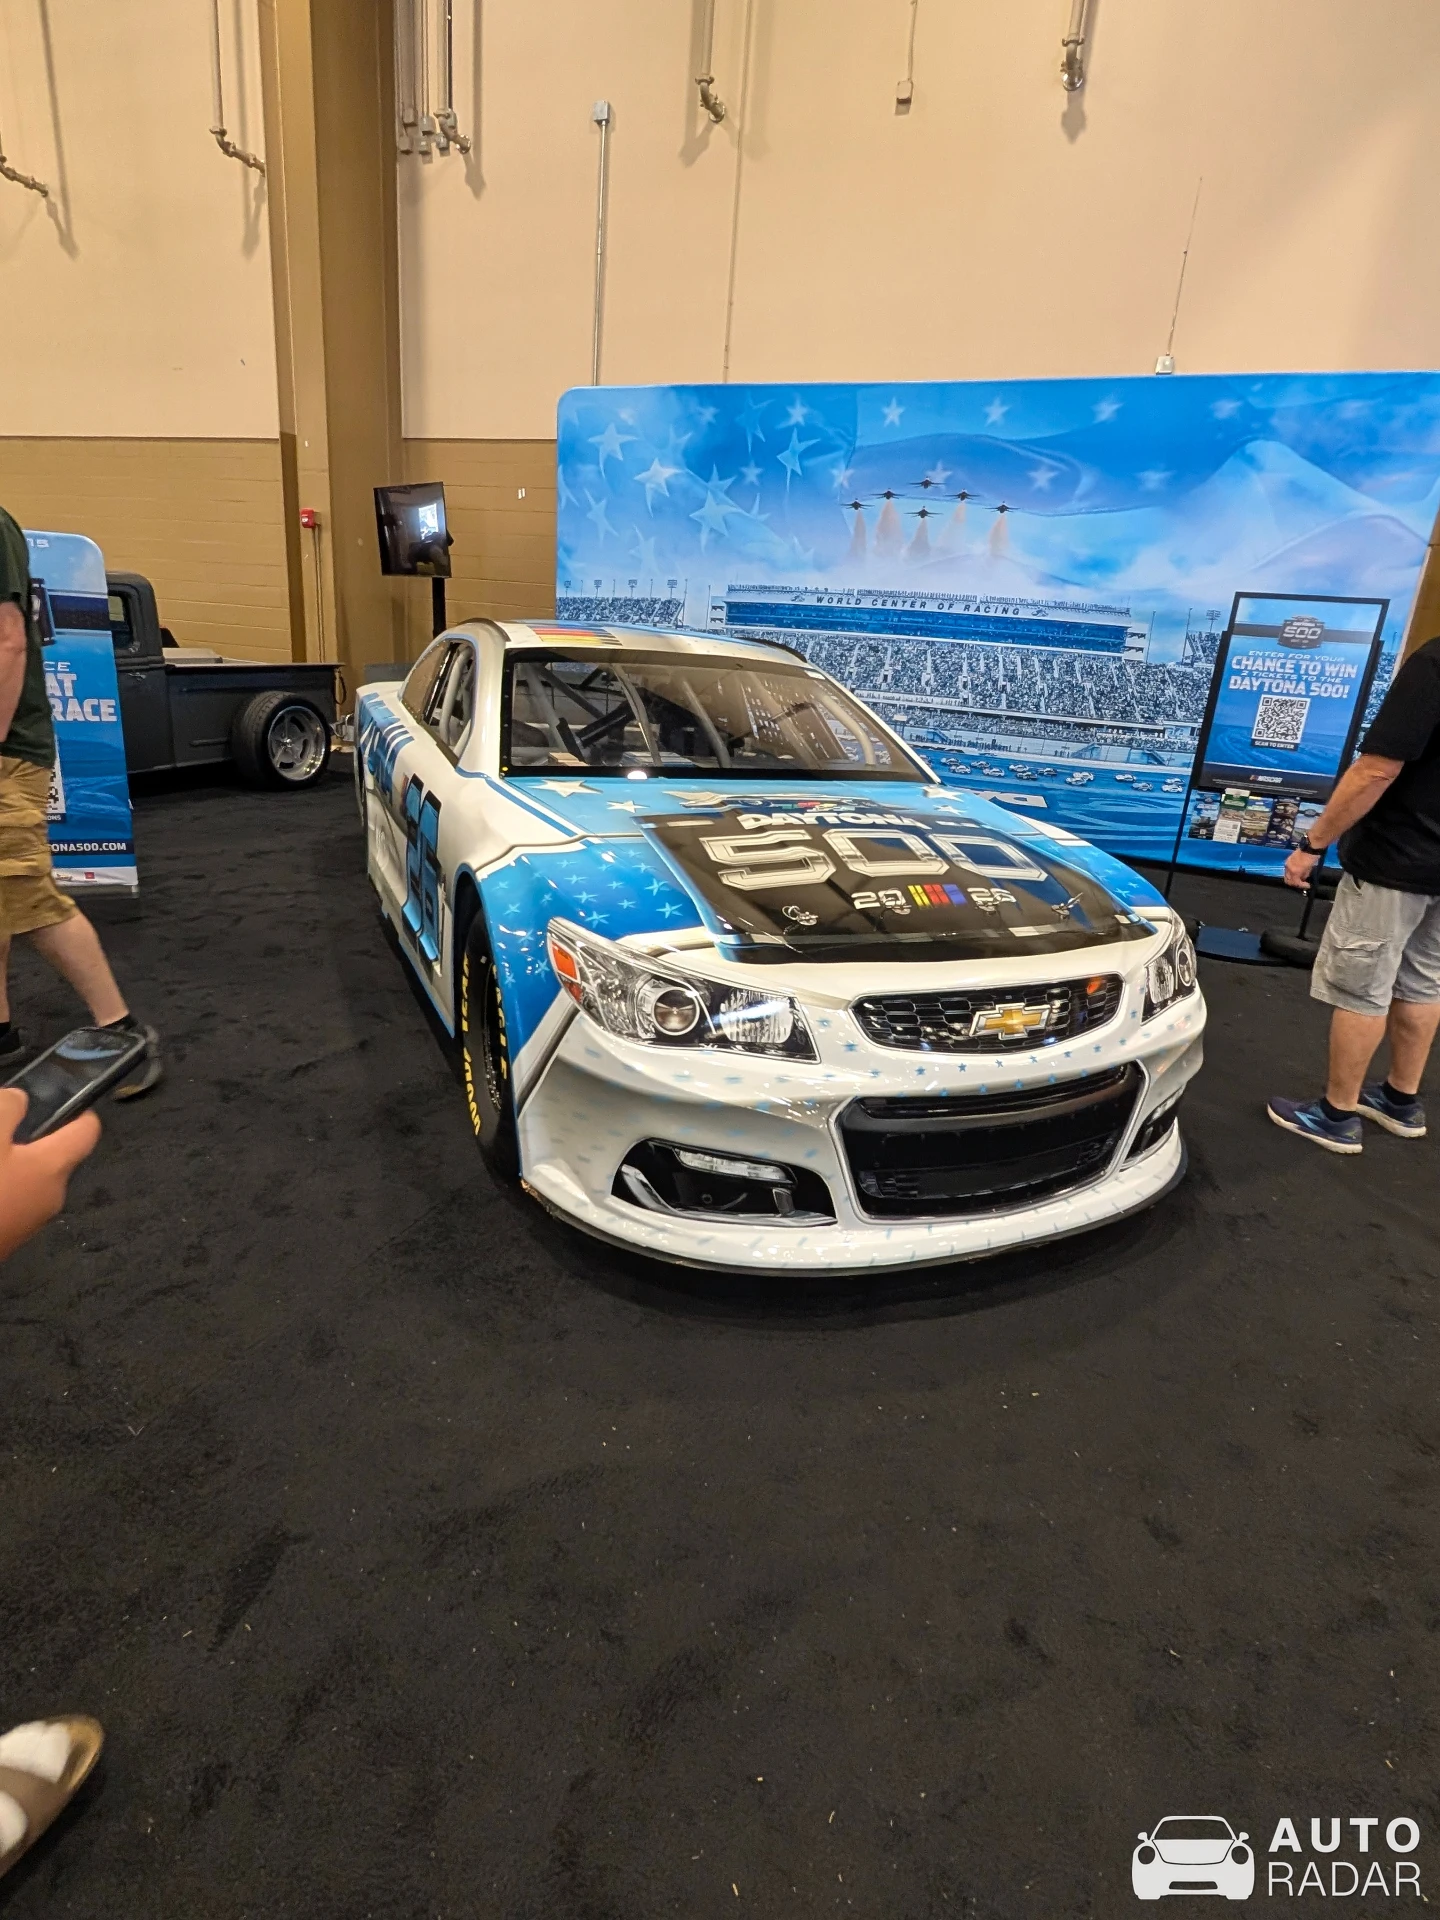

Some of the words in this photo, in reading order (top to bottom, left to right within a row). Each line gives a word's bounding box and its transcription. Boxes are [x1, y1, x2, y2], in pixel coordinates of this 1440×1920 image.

[816, 595, 862, 606] WORLD
[871, 598, 927, 610] CENTER
[937, 602, 955, 610] OF
[963, 603, 1021, 616] RACING
[1283, 626, 1322, 639] 500
[1248, 650, 1284, 658] ENTER
[1288, 653, 1311, 661] FOR
[1231, 655, 1296, 674] CHANCE
[1299, 660, 1321, 676] TO
[1324, 662, 1359, 678] WIN
[1252, 671, 1298, 680] TICKETS
[1228, 675, 1307, 695] DAYTONA
[1309, 682, 1351, 699] 500!
[736, 812, 932, 830] DAYTONA
[699, 828, 1049, 890] 500
